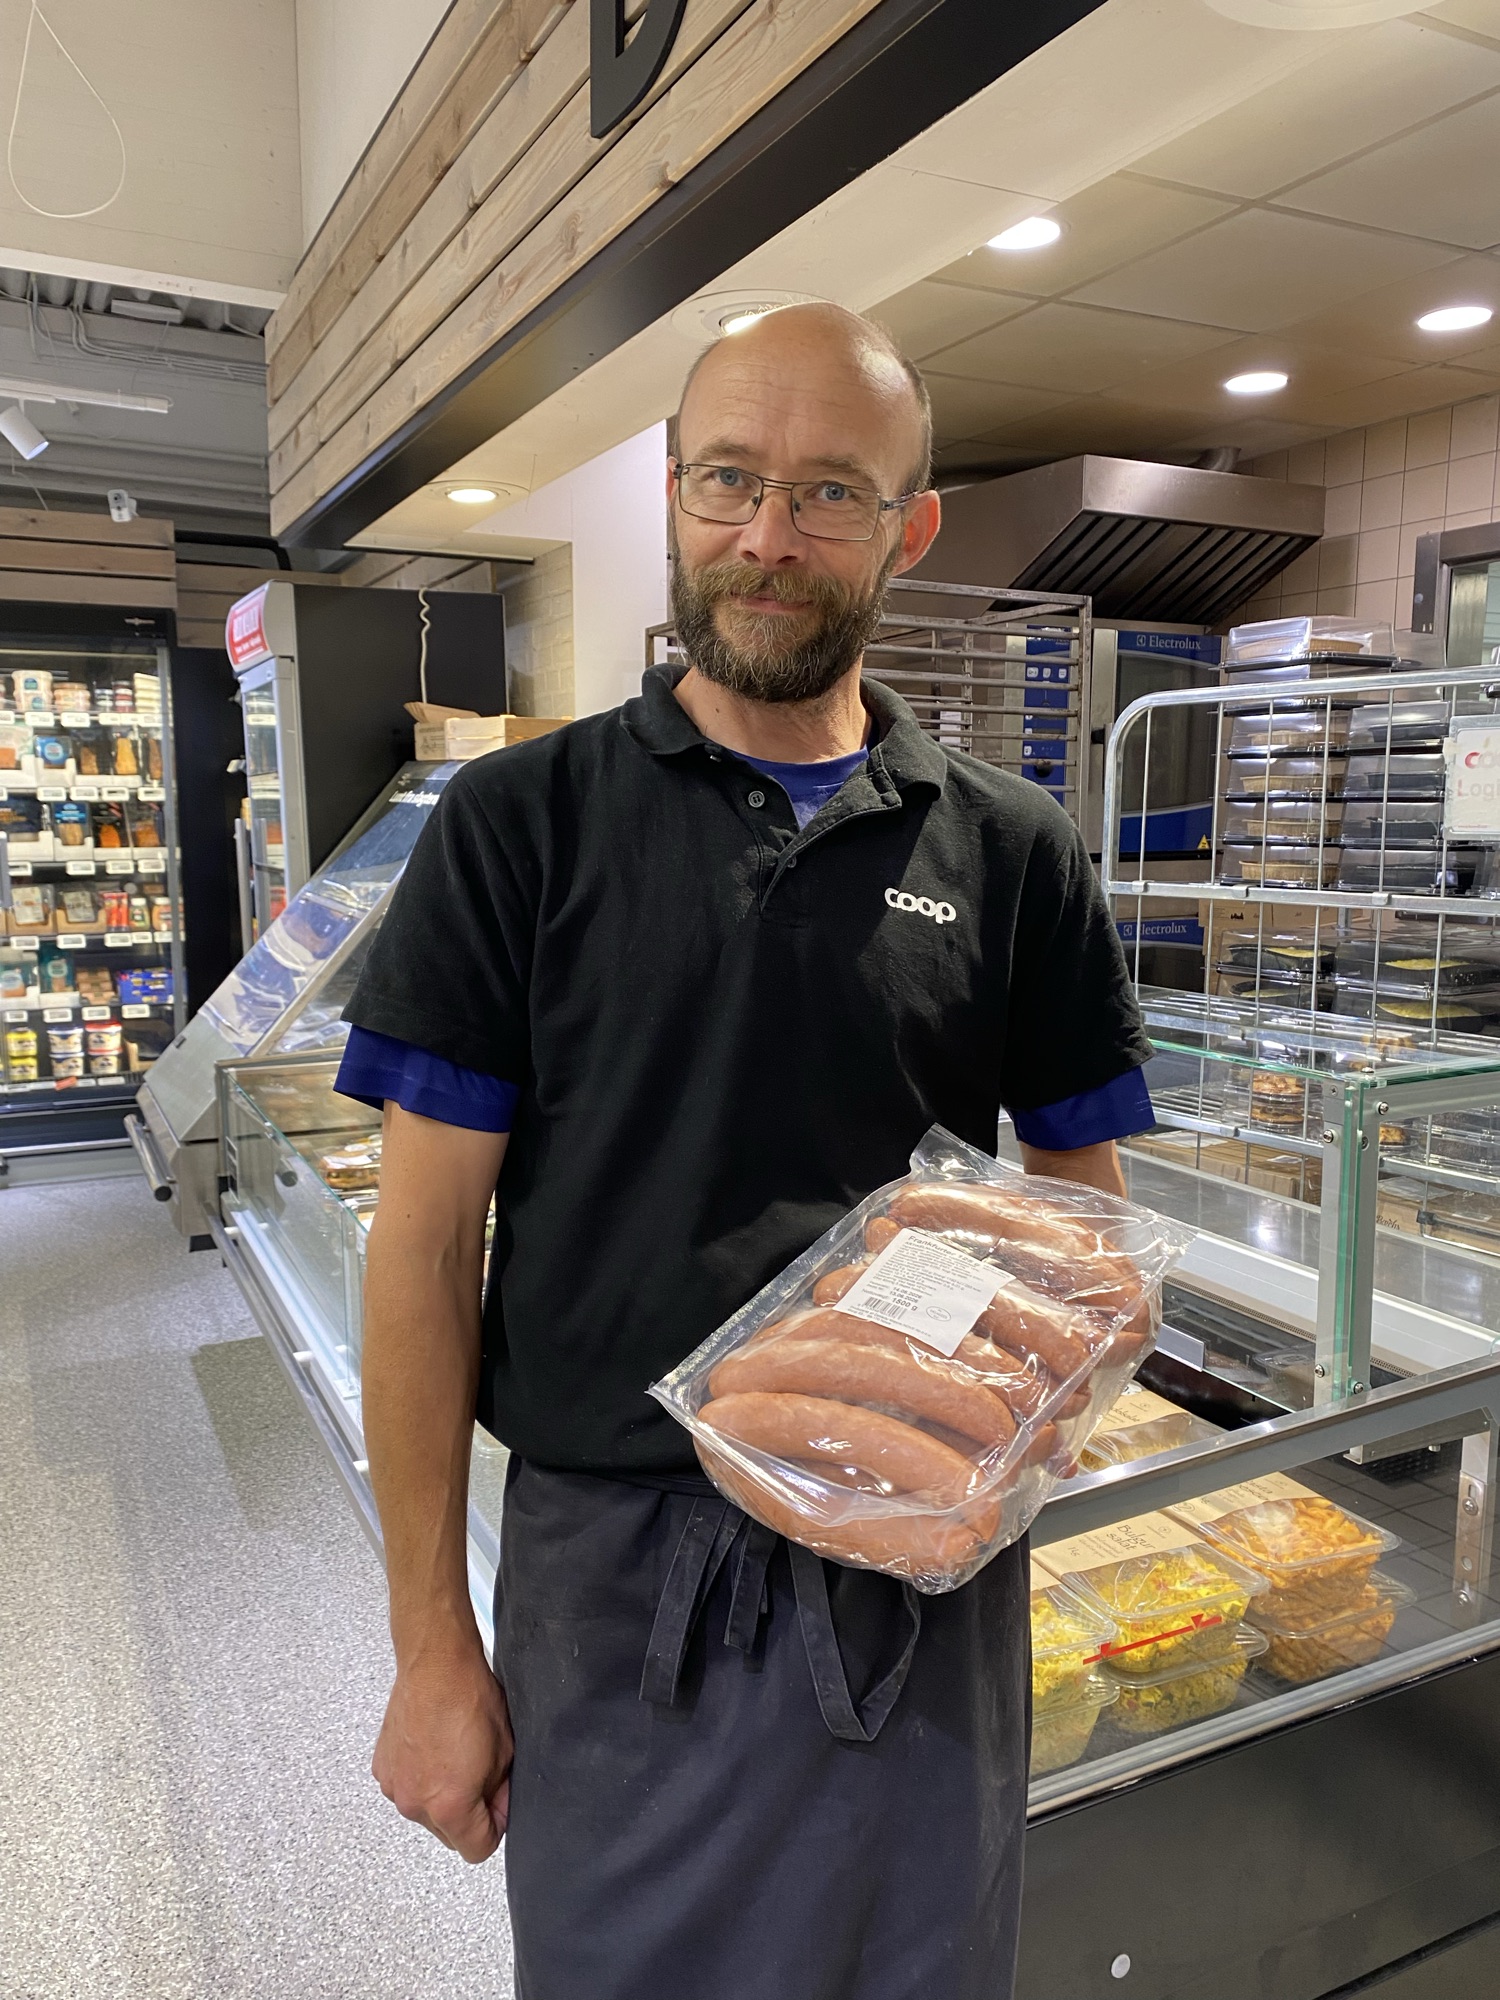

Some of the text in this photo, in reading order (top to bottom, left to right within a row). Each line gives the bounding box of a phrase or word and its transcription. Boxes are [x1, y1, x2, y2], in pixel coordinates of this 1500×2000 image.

[1149, 636, 1201, 650] Electrolux
[884, 887, 957, 924] coop
[1136, 922, 1187, 936] lectrolux
[908, 1235, 956, 1257] Frankfurter
[892, 1298, 911, 1308] 1500
[1106, 1533, 1137, 1551] salat
[1117, 1524, 1157, 1550] Bulgur
